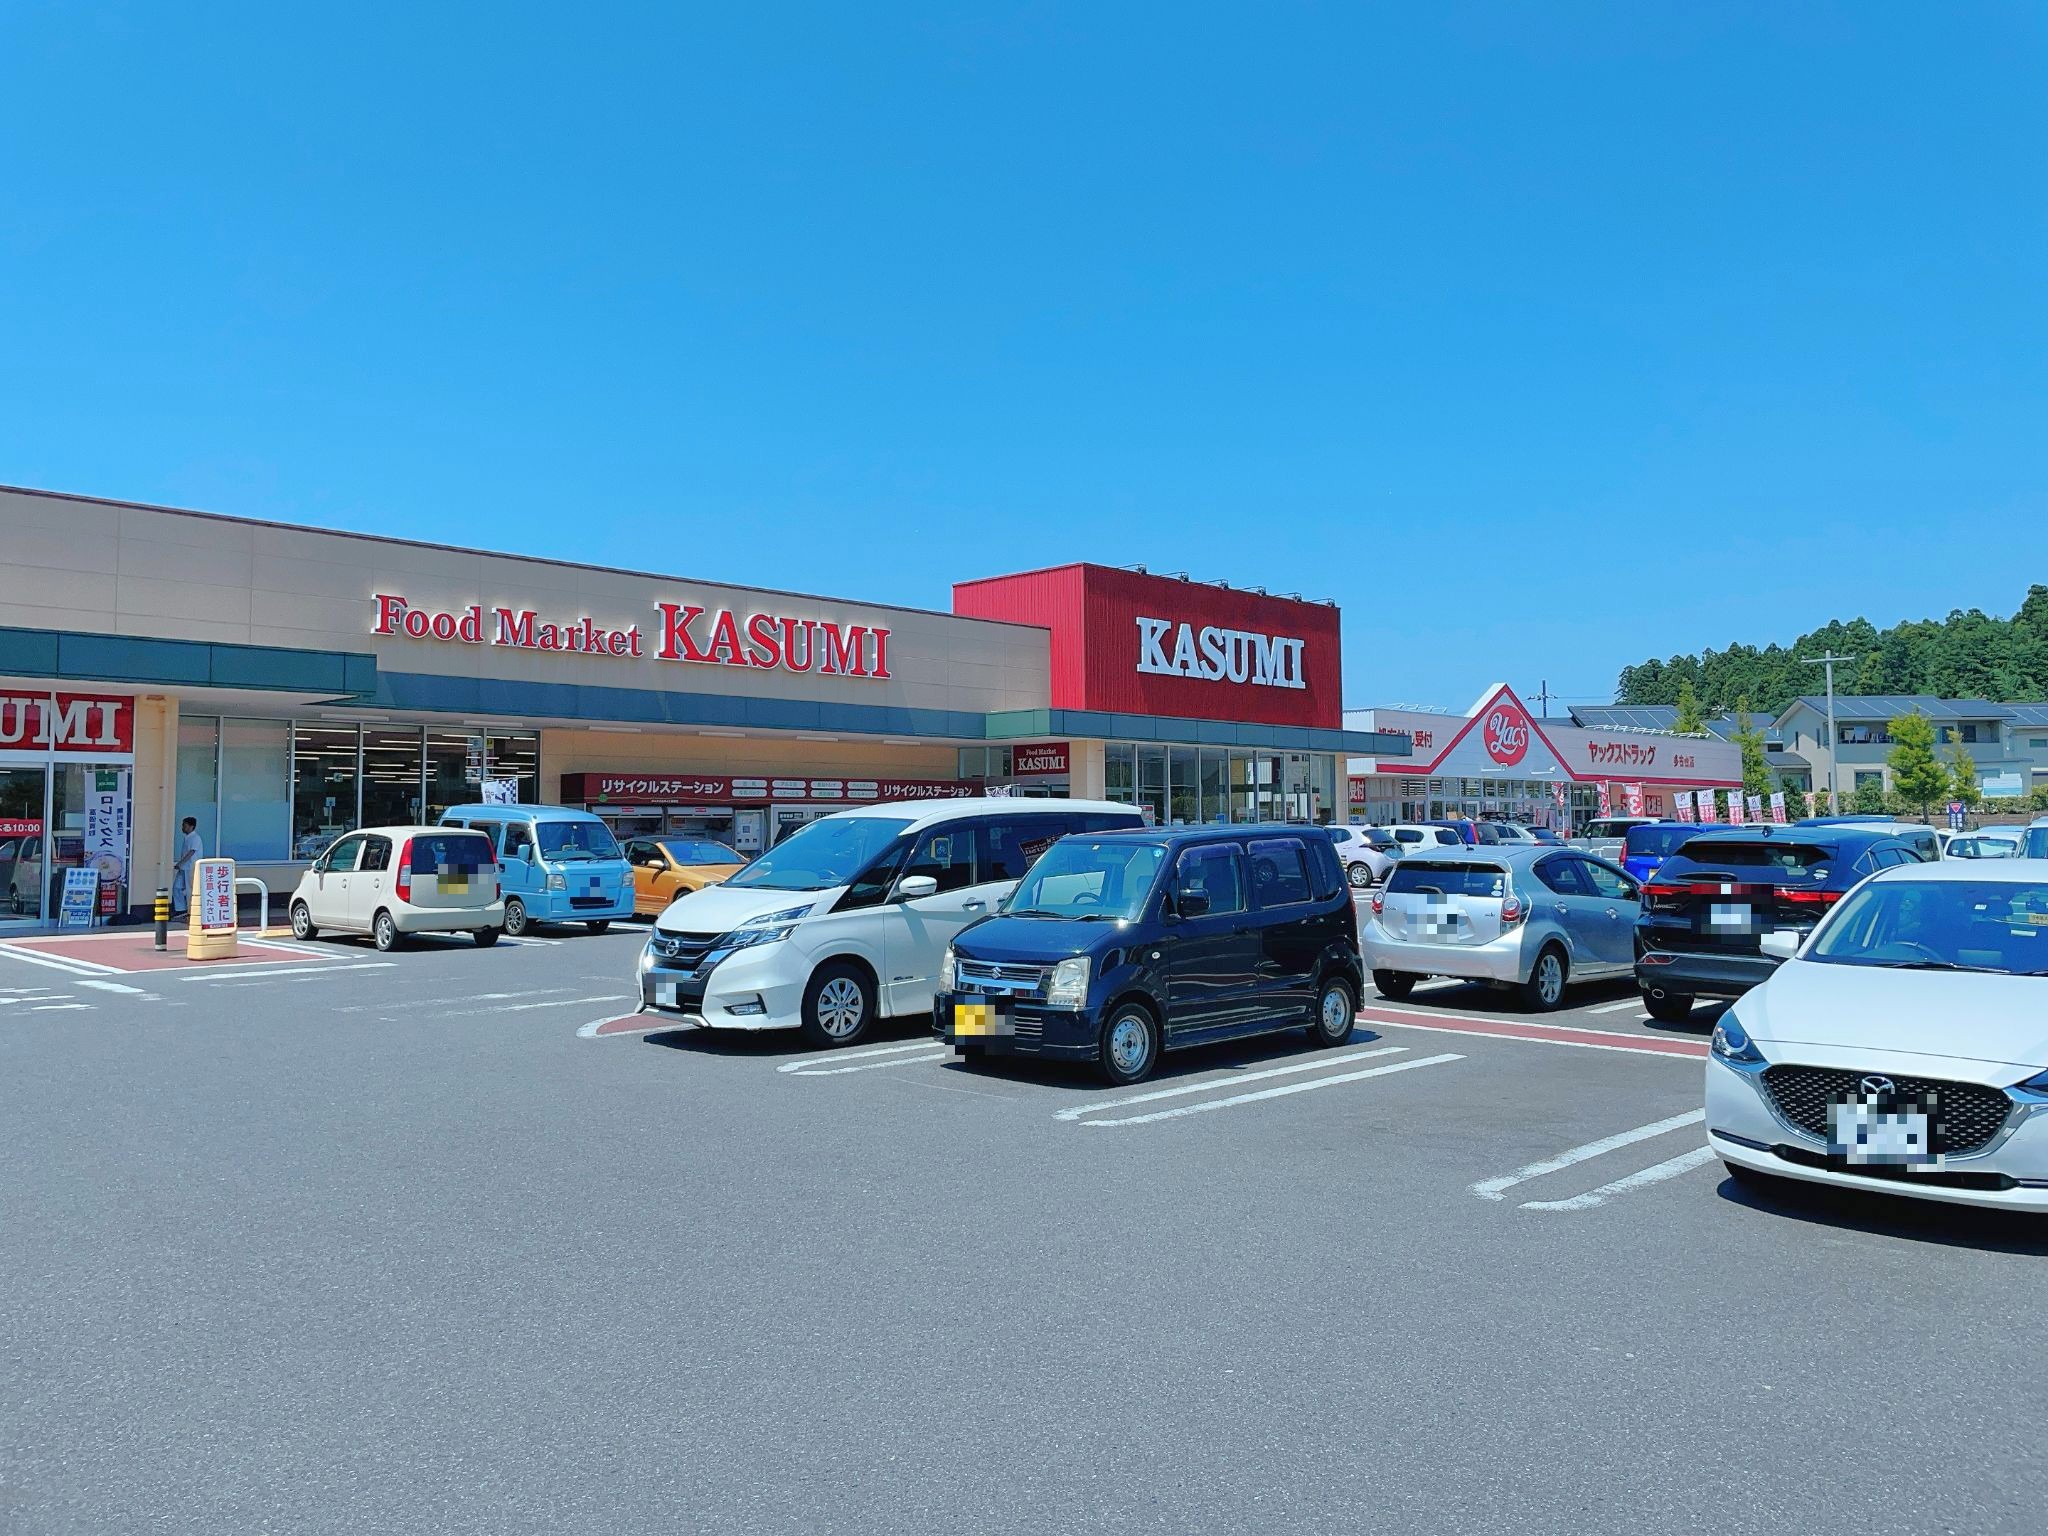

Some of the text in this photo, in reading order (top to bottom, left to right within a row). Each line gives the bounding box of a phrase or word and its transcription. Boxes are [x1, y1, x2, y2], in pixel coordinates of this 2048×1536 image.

[371, 594, 893, 680] Food Market KASUMI
[1136, 616, 1306, 689] KASUMI
[1490, 712, 1528, 755] Yac's
[1018, 756, 1065, 771] KASUMI
[1038, 748, 1057, 756] Market
[1589, 741, 1656, 765] ヤックスドラッグ
[602, 779, 724, 794] リサイクルステーション
[884, 784, 973, 797] リサイクルステーション
[217, 866, 230, 921] 歩行者に
